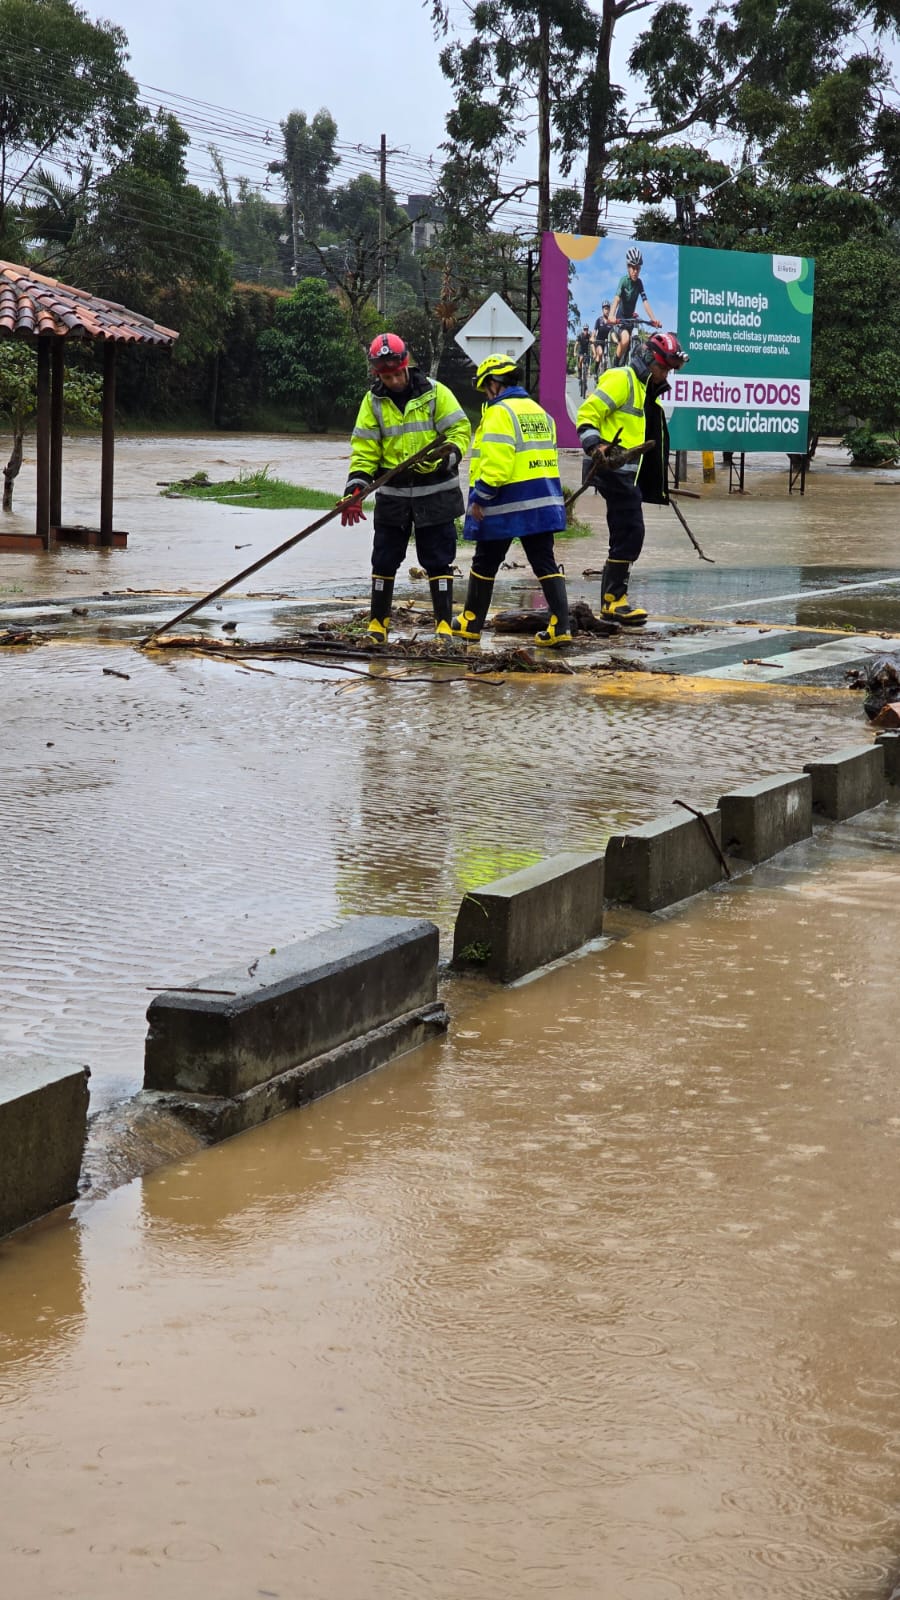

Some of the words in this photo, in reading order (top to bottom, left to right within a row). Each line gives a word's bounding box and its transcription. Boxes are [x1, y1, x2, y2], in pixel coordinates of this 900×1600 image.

[690, 288, 725, 306] ¡Pilas!
[727, 291, 768, 312] Maneja
[690, 310, 712, 324] con
[714, 310, 762, 328] cuidado
[690, 328, 696, 337] A
[697, 330, 732, 341] peatones,
[733, 331, 762, 341] ciclistas
[763, 334, 767, 344] y
[768, 334, 801, 344] mascotas
[690, 341, 704, 351] nos
[704, 342, 733, 352] encanta
[733, 344, 763, 354] recorrer
[763, 345, 778, 355] esta
[675, 380, 689, 402] El
[692, 381, 742, 404] Retiro
[744, 383, 801, 406] TODOS
[697, 414, 725, 432] nos
[727, 411, 799, 434] cuidamos
